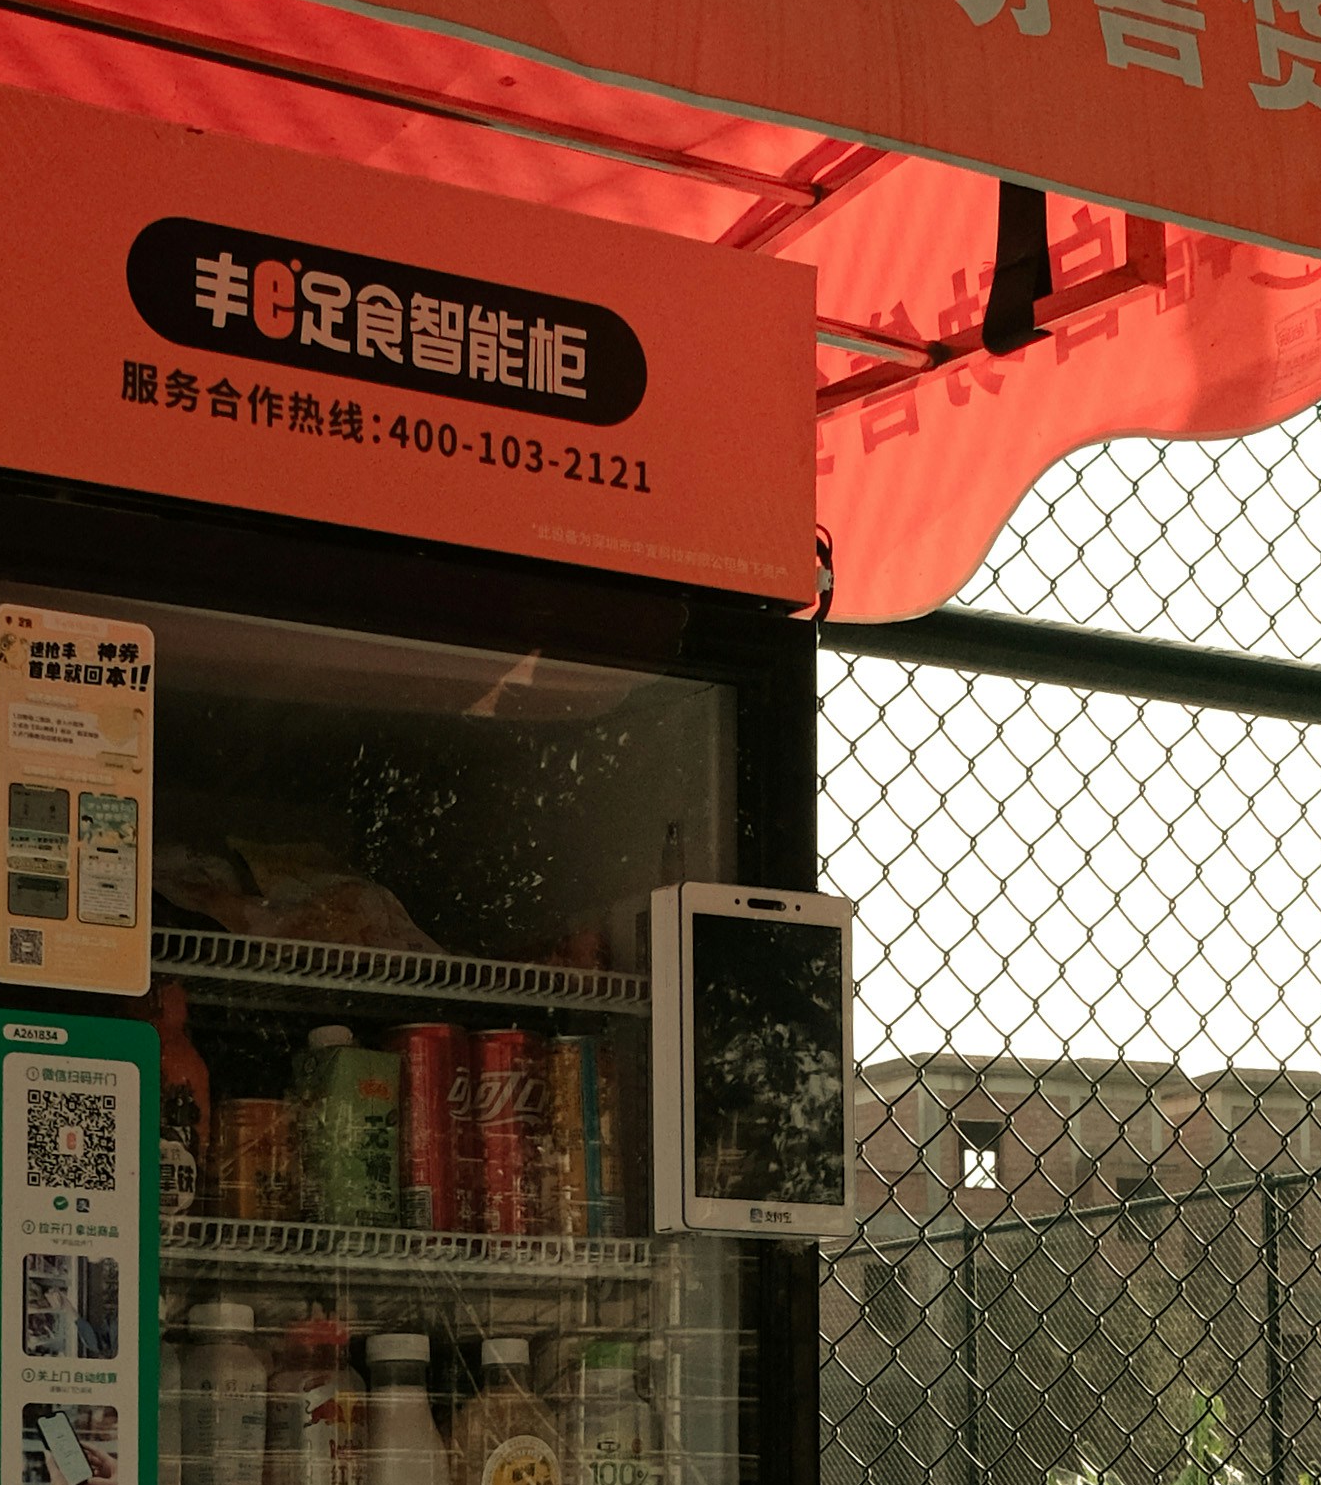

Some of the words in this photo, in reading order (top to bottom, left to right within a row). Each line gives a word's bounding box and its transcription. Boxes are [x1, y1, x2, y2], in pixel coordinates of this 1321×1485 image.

[195, 251, 588, 400] 丰e足食智能柜
[13, 1028, 58, 1041] A261834
[764, 1210, 792, 1224] 支付宝
